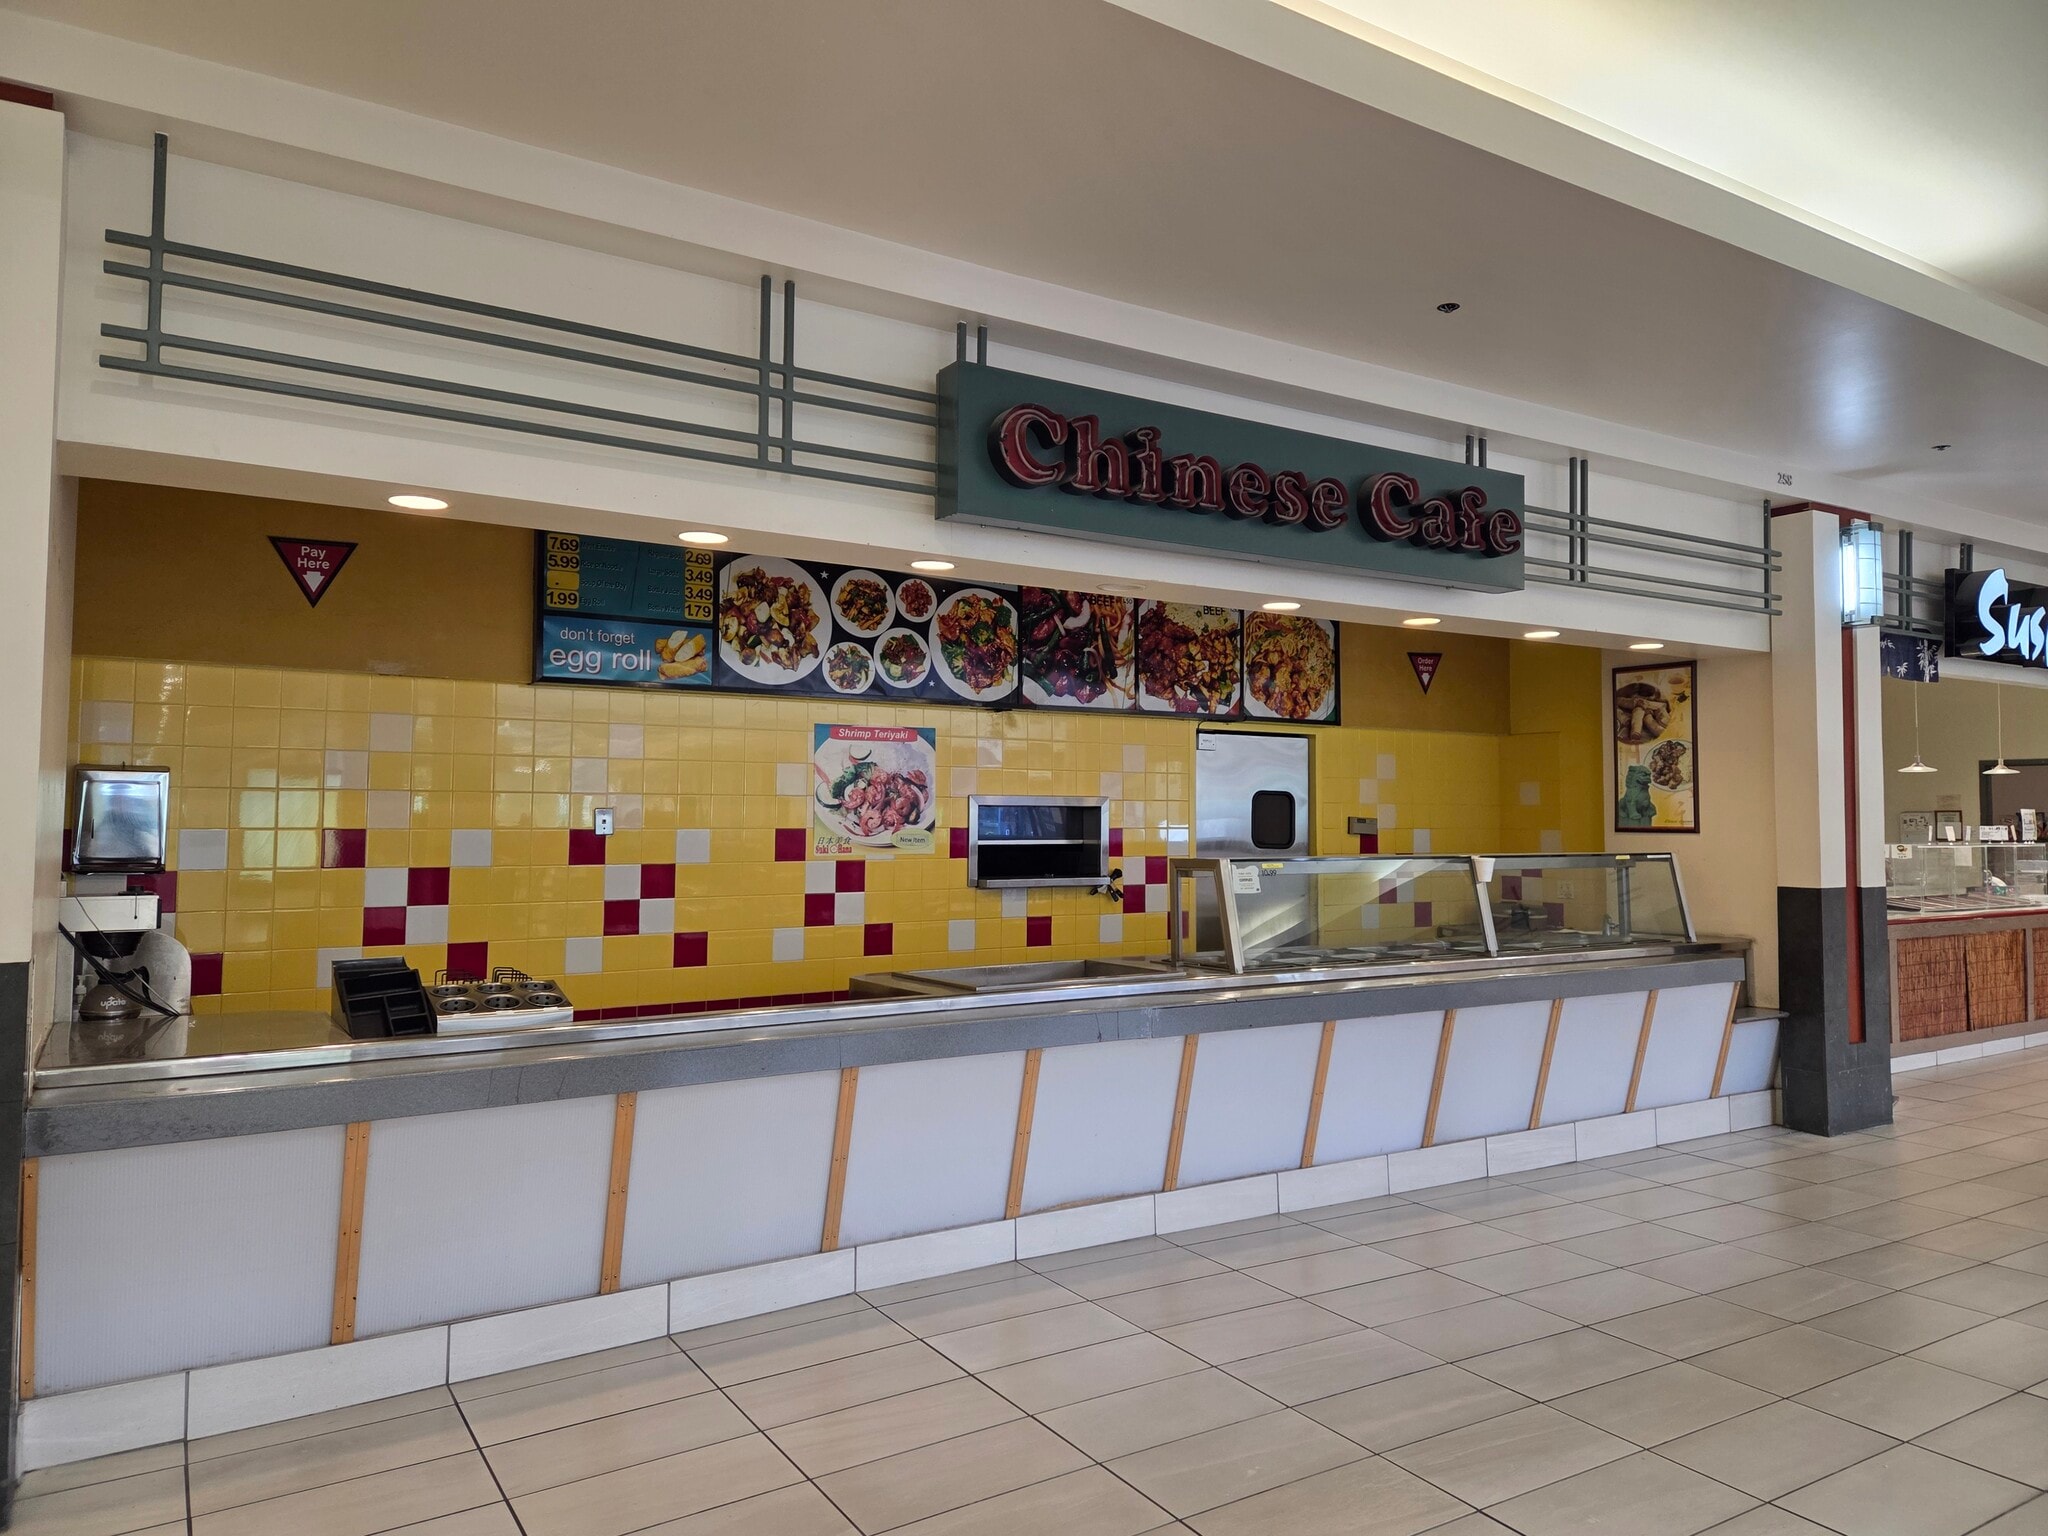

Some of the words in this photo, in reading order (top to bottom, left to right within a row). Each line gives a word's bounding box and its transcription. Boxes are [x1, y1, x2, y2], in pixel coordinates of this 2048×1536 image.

[987, 402, 1349, 533] Chinese
[1357, 471, 1522, 558] Cafe
[550, 536, 579, 551] 7.69
[301, 545, 326, 560] Pay
[686, 550, 712, 566] 2.69
[297, 557, 330, 570] Here
[548, 554, 580, 569] 5.99
[685, 568, 713, 584] 3.49
[547, 591, 578, 606] 1.99
[685, 586, 713, 602] 3.49
[686, 603, 712, 618] 1.79
[1978, 568, 2048, 668] Sus
[560, 626, 594, 642] don't
[597, 629, 635, 647] forget
[550, 648, 602, 674] egg
[612, 649, 651, 671] roll
[838, 728, 872, 739] Shrimp
[874, 729, 909, 740] Teriyaki
